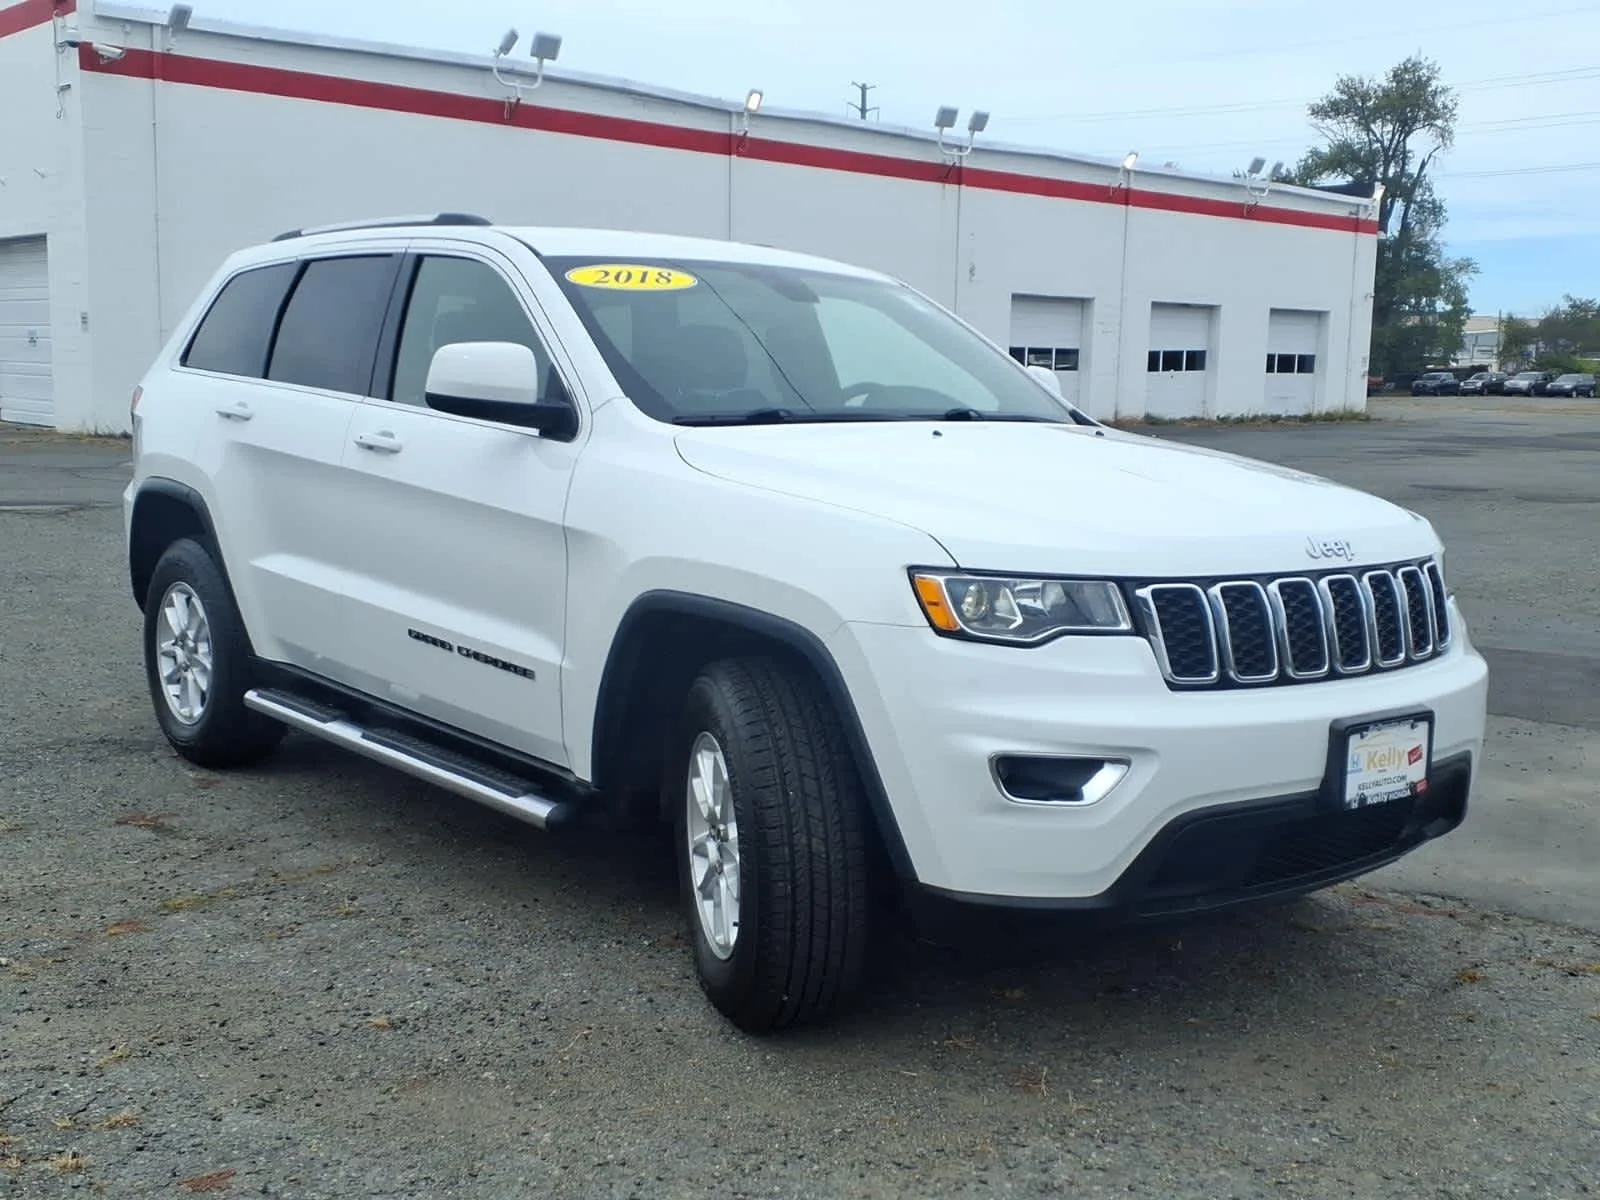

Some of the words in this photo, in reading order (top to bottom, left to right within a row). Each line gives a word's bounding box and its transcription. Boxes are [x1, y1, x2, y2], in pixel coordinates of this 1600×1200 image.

[593, 269, 672, 285] 2018
[1305, 535, 1355, 562] Jeep
[407, 627, 455, 652] GRAND
[457, 645, 537, 681] CHEROKEE
[1366, 747, 1406, 770] Kelly
